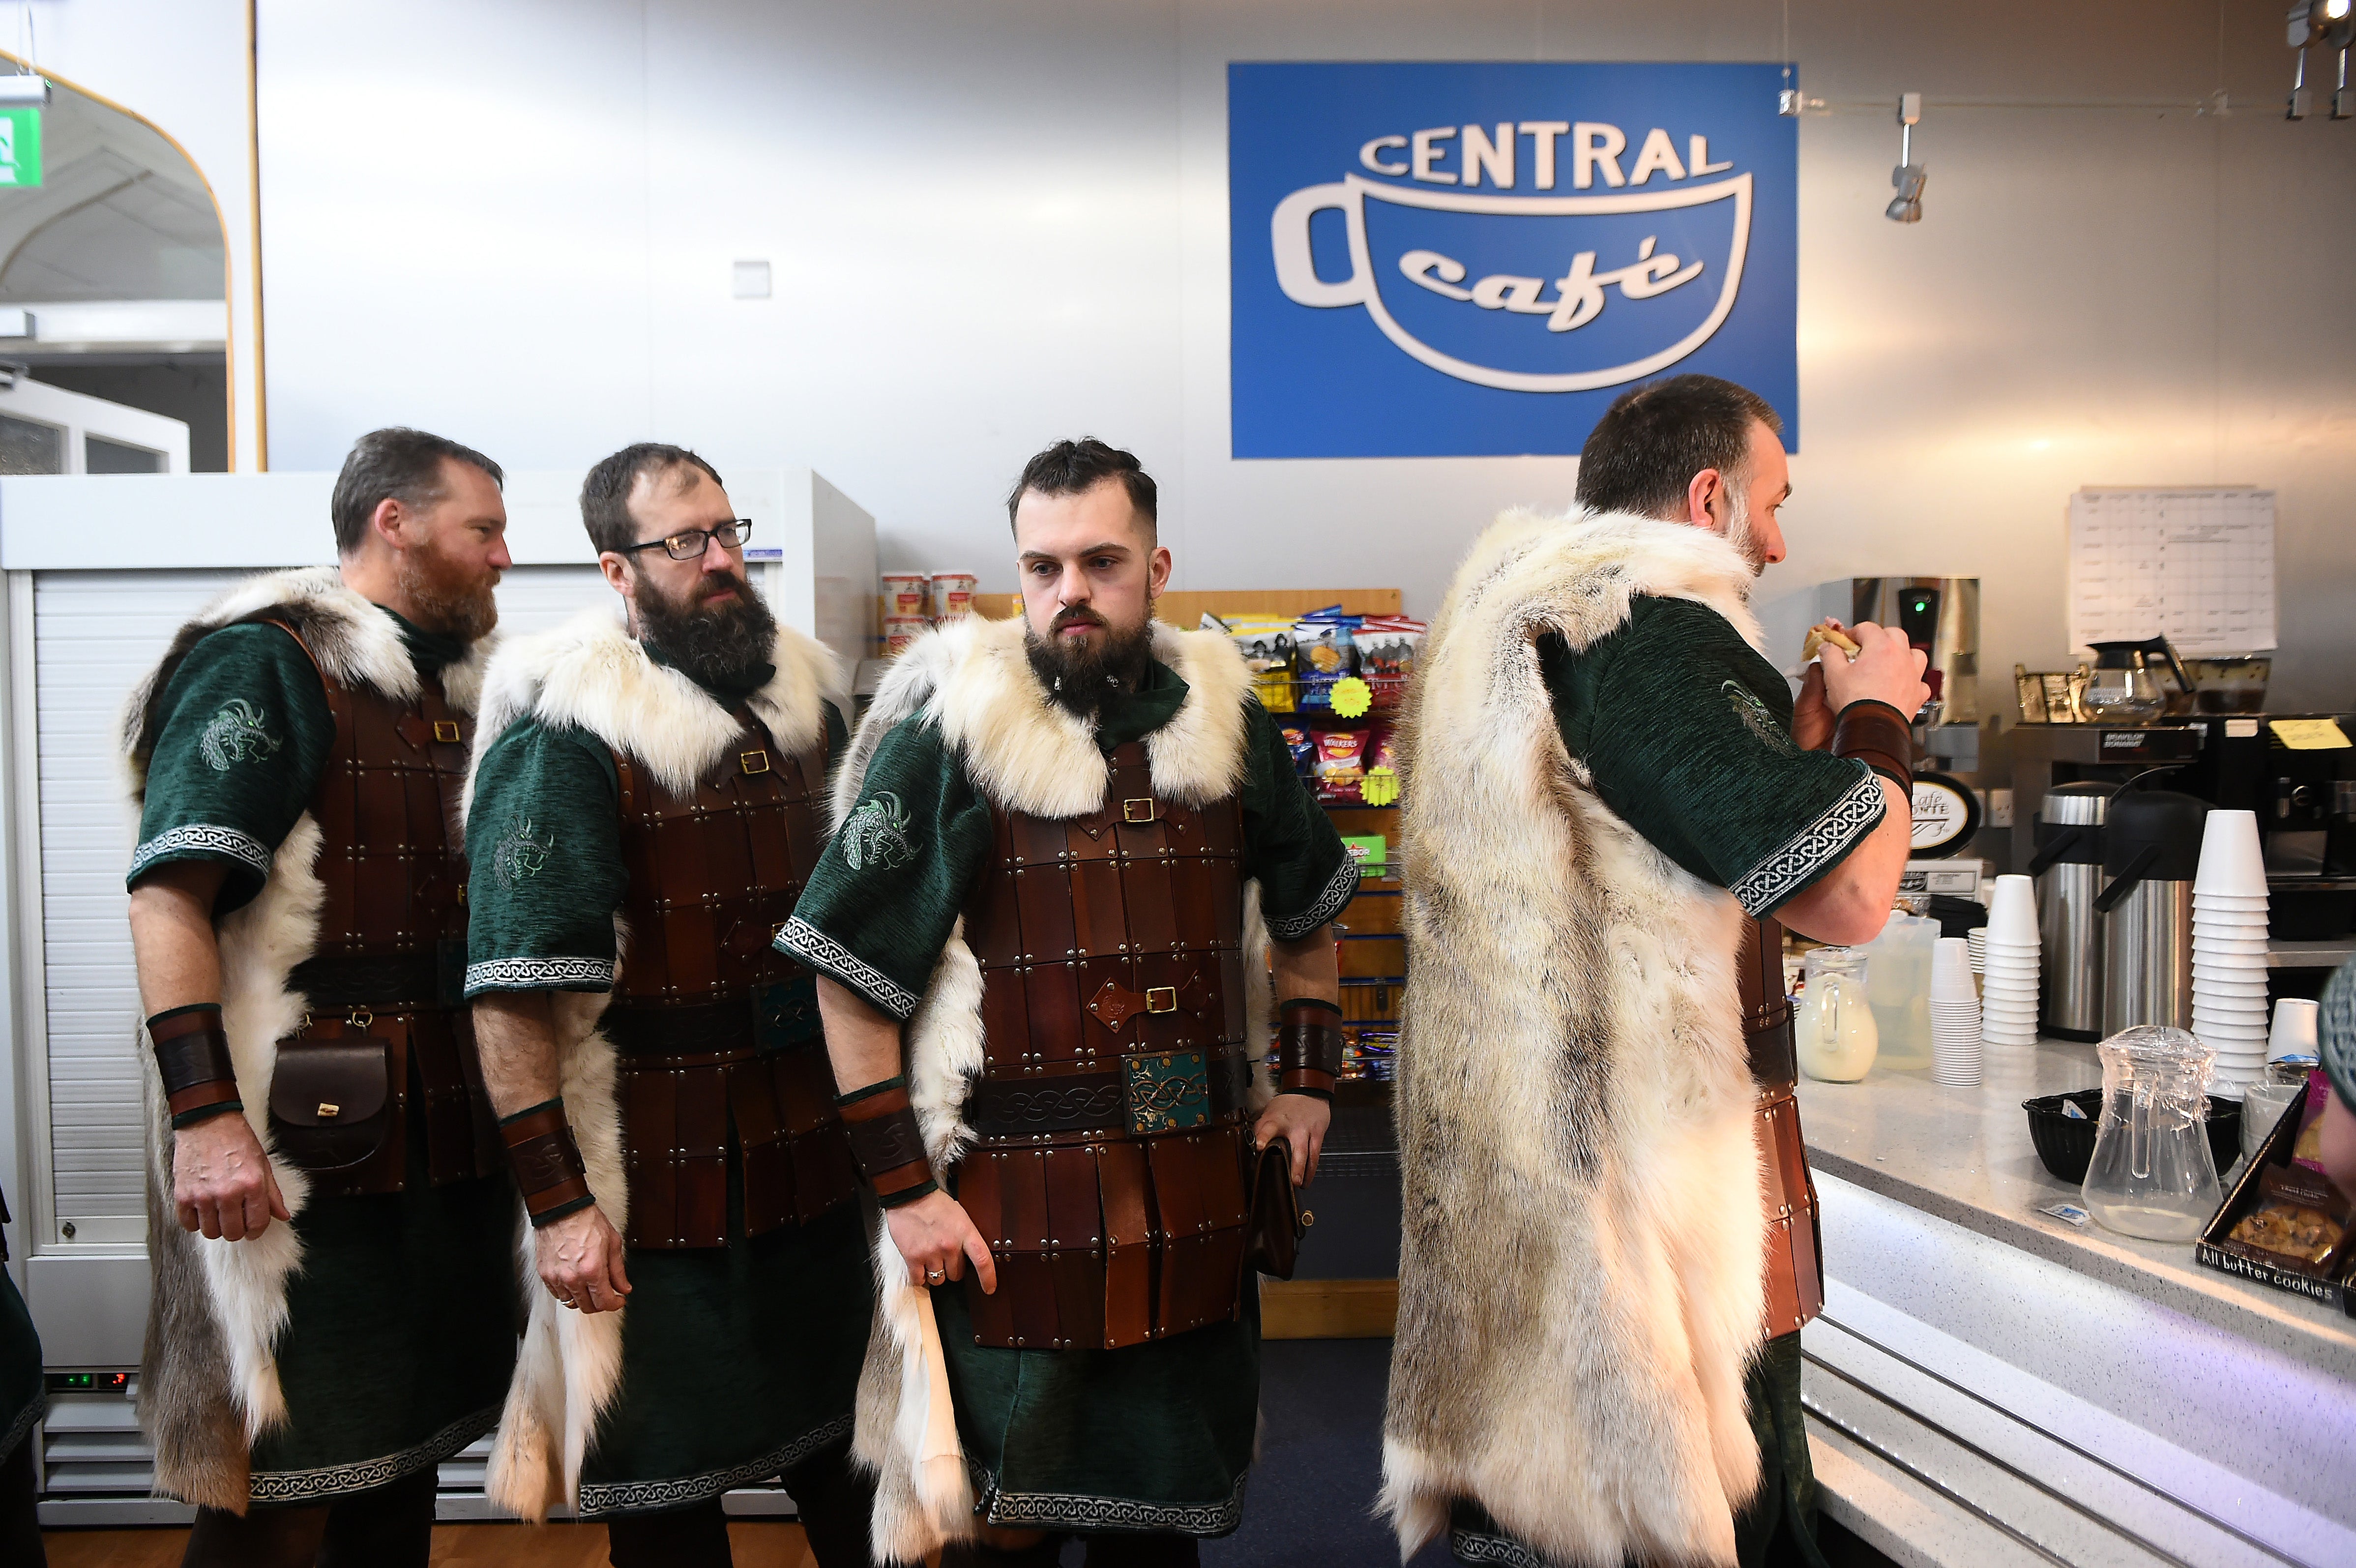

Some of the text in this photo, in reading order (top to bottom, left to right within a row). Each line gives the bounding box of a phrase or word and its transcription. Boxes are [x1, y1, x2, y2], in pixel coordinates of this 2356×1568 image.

[1359, 121, 1733, 190] CENTRAL
[1398, 235, 1704, 332] café
[1324, 739, 1358, 748] WALKERS
[2202, 1247, 2219, 1266] All
[2223, 1253, 2269, 1281] butter
